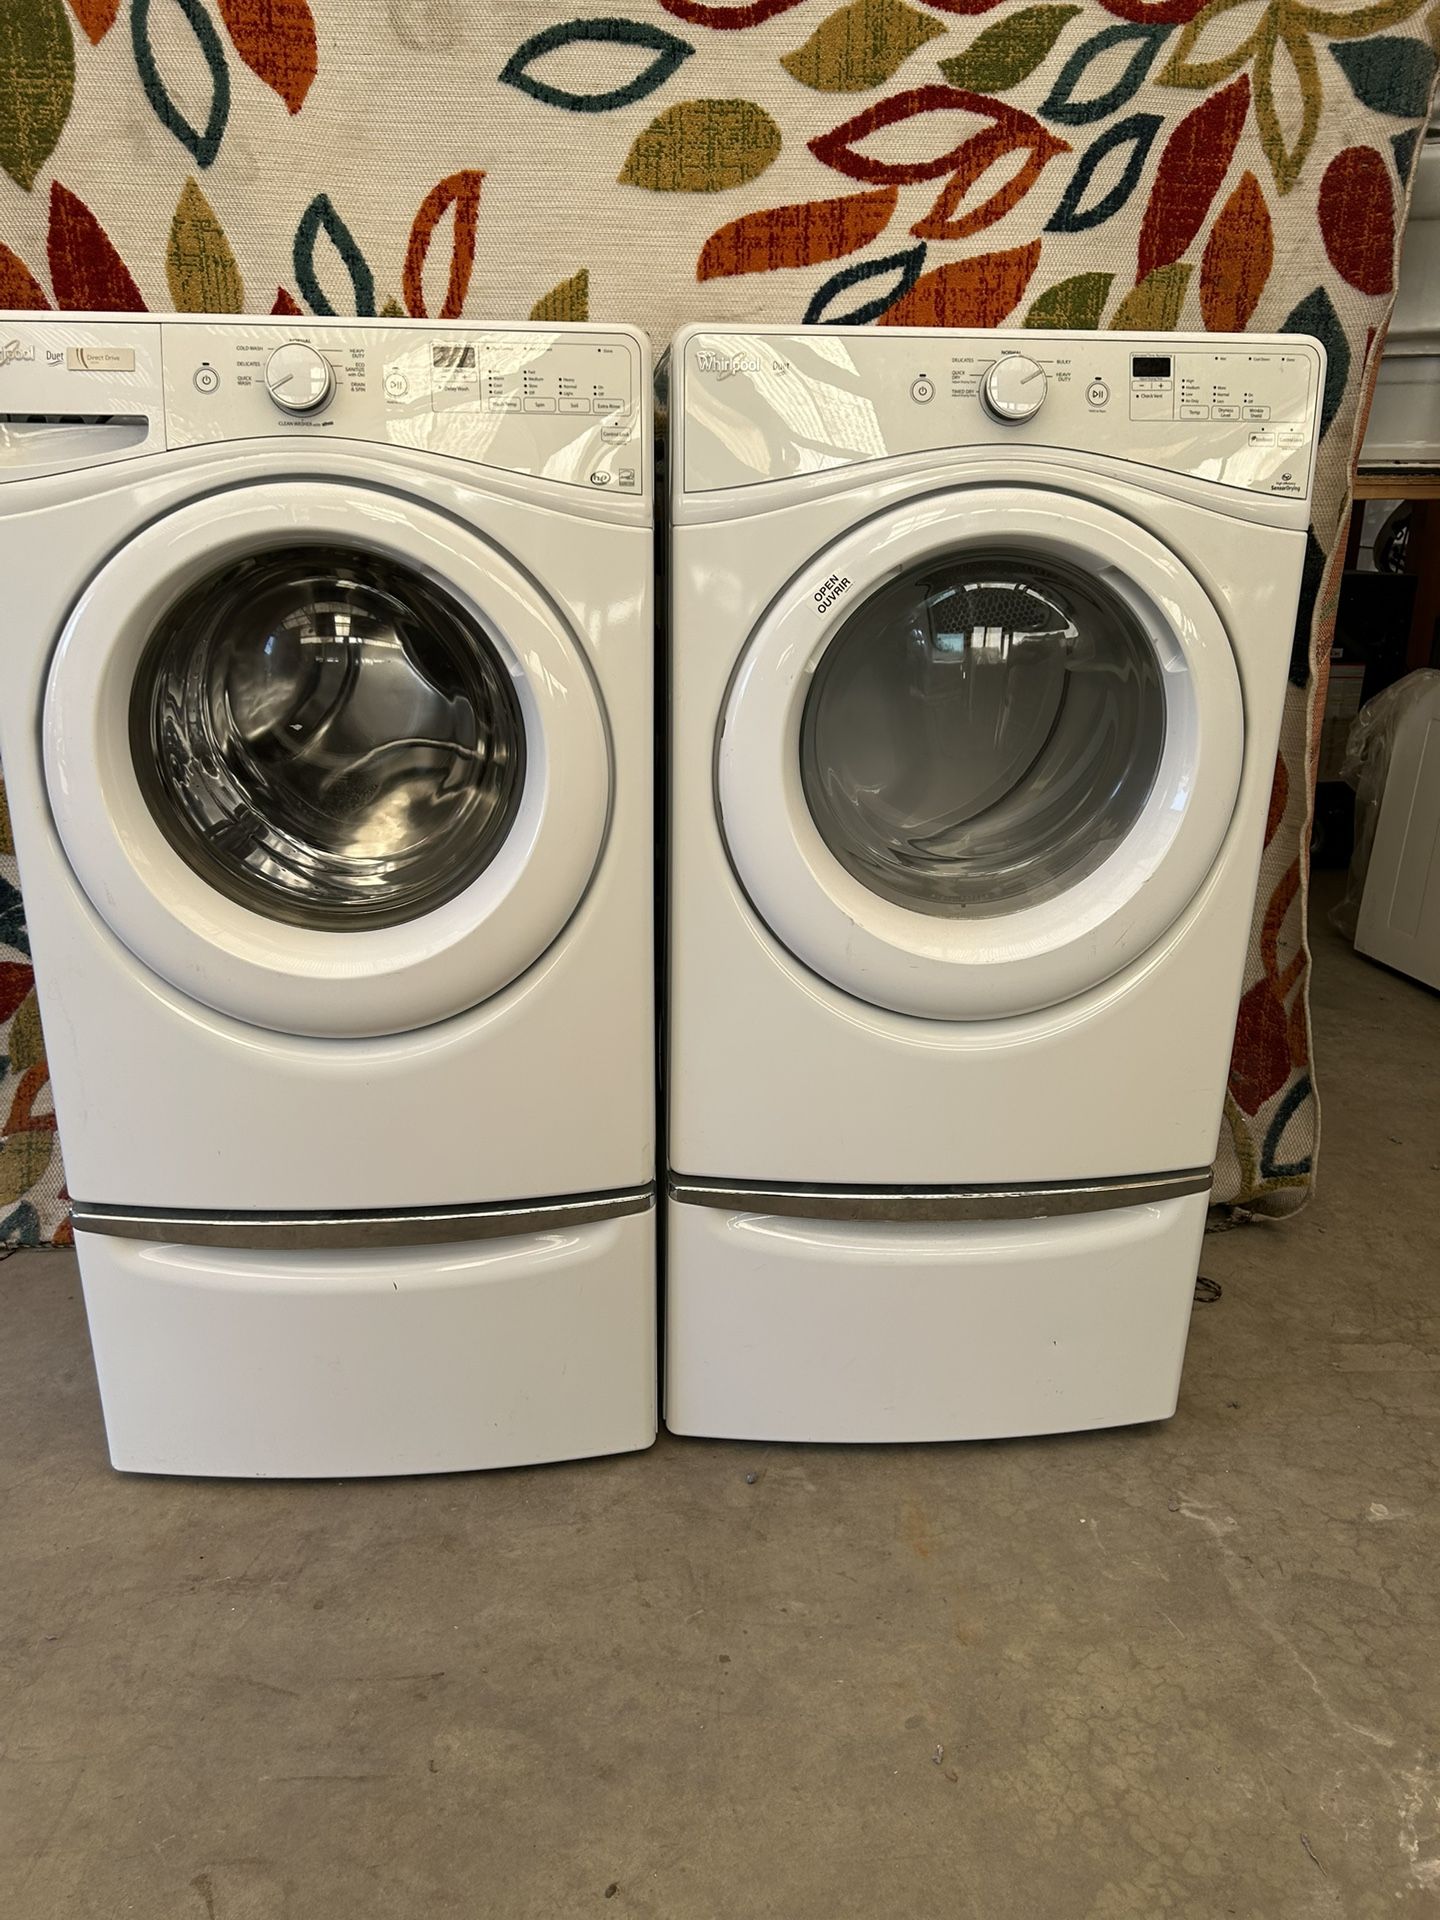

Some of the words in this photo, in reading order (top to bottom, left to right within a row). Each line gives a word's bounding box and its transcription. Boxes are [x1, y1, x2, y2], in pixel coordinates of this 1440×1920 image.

[46, 350, 64, 361] Duet
[696, 353, 761, 377] Whirlpool
[814, 574, 839, 602] OPEN
[817, 577, 851, 613] OUVRIR
